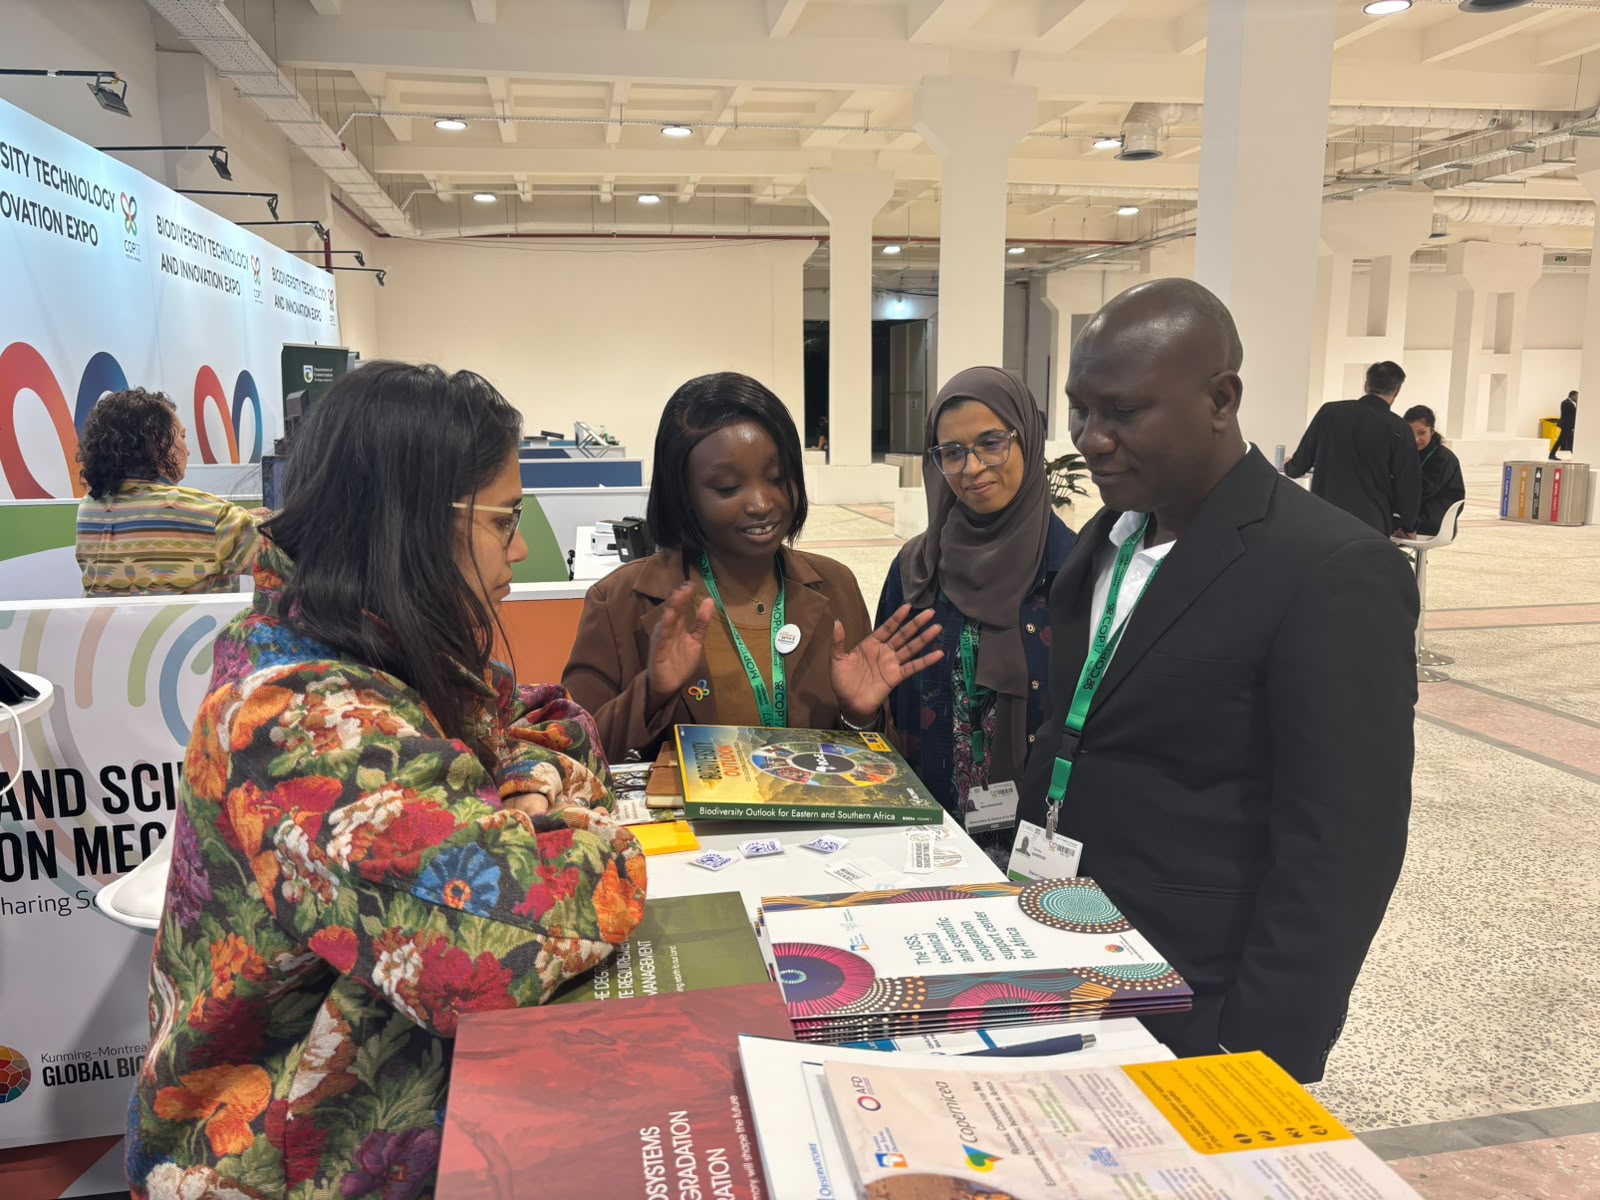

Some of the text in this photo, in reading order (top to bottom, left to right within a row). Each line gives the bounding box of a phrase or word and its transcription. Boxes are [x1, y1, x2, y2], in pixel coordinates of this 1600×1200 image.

[32, 156, 116, 214] TECHNOLOGY
[0, 190, 98, 247] OVATION EXPO
[156, 214, 250, 271] BIODIVERSITY TECHNOLOGY
[161, 252, 180, 276] AND
[180, 258, 224, 291] INNOVATION
[224, 275, 241, 296] EXPO
[274, 293, 285, 310] AND
[0, 762, 184, 822] AND SCI
[700, 807, 896, 821] Biodiversity Outlook for Eastern and Southern Africa
[0, 829, 58, 883] ON
[903, 933, 932, 965] The OSS,
[922, 932, 953, 964] technical
[936, 917, 976, 963] and scientific
[961, 920, 995, 962] cooperation
[974, 911, 1017, 961] support center
[1006, 927, 1038, 960] for Africa
[42, 1060, 114, 1087] GLOBAL
[851, 1076, 868, 1094] AFD
[730, 1095, 743, 1118] future
[735, 1119, 746, 1133] the
[935, 1080, 978, 1144] Copernicea
[639, 1126, 669, 1200] OSYSTEMS
[668, 1110, 702, 1200] GRADATION
[739, 1134, 753, 1161] shape
[743, 1162, 756, 1178] will
